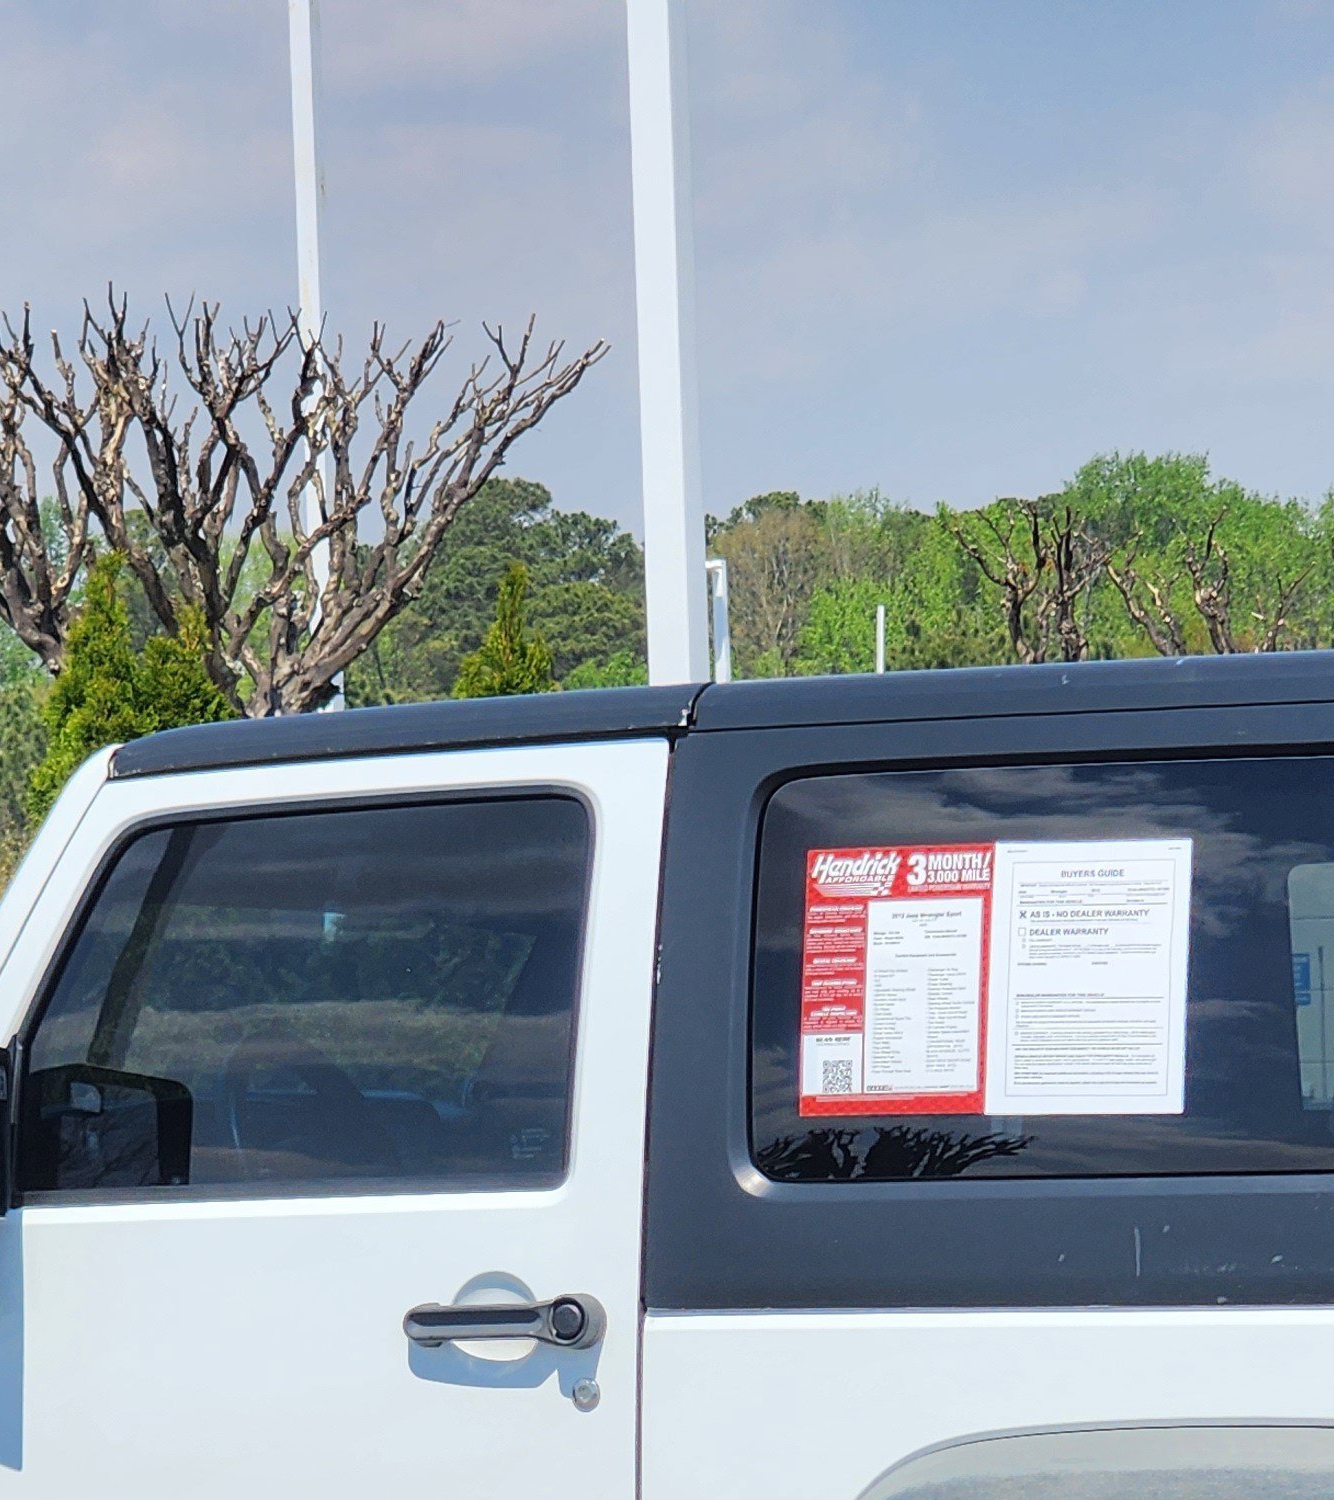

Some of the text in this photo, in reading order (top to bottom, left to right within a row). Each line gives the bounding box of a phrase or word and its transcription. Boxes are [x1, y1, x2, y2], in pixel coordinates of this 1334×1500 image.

[811, 851, 902, 884] Hendrick
[907, 853, 926, 886] 3
[826, 873, 895, 884] AFFORDABLE
[927, 868, 990, 884] 3,000 MILE
[1060, 869, 1125, 878] BUYERS GUIDE
[1056, 910, 1068, 918] NO
[1070, 910, 1103, 918] DEALER
[1104, 909, 1150, 917] WARRANTY
[1063, 928, 1109, 936] WARRANTY
